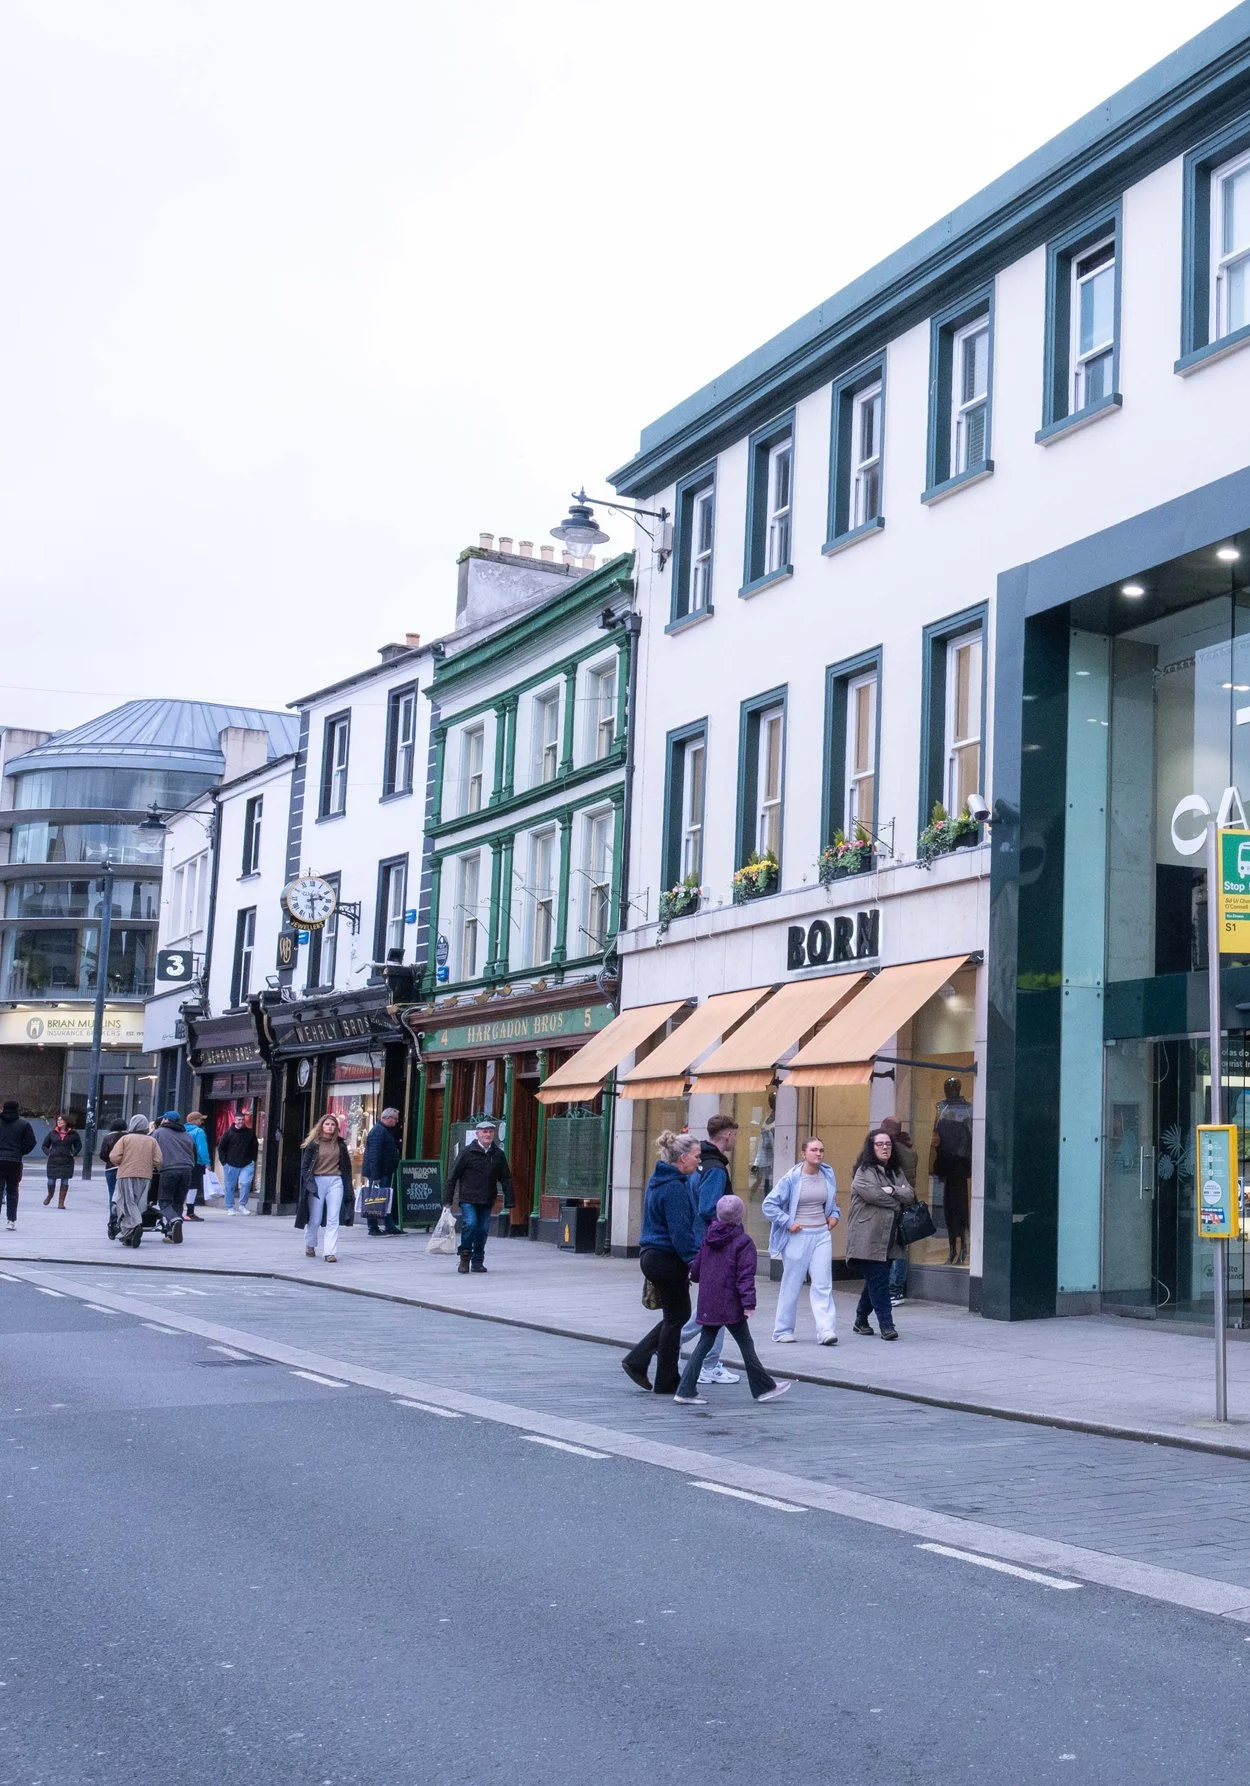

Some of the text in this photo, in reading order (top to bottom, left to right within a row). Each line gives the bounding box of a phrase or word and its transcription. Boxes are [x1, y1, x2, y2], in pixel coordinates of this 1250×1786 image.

[1224, 881, 1245, 893] Stop
[290, 920, 324, 930] JEWELLERS
[1225, 923, 1236, 932] S1
[787, 909, 879, 970] BORN
[166, 955, 185, 976] 3
[47, 1020, 121, 1028] BRIAN MUINS
[440, 1030, 448, 1046] 4
[467, 1020, 528, 1043] HARGADON
[584, 1009, 591, 1028] 5
[1221, 1048, 1238, 1057] olas
[1222, 1060, 1243, 1068] ourist
